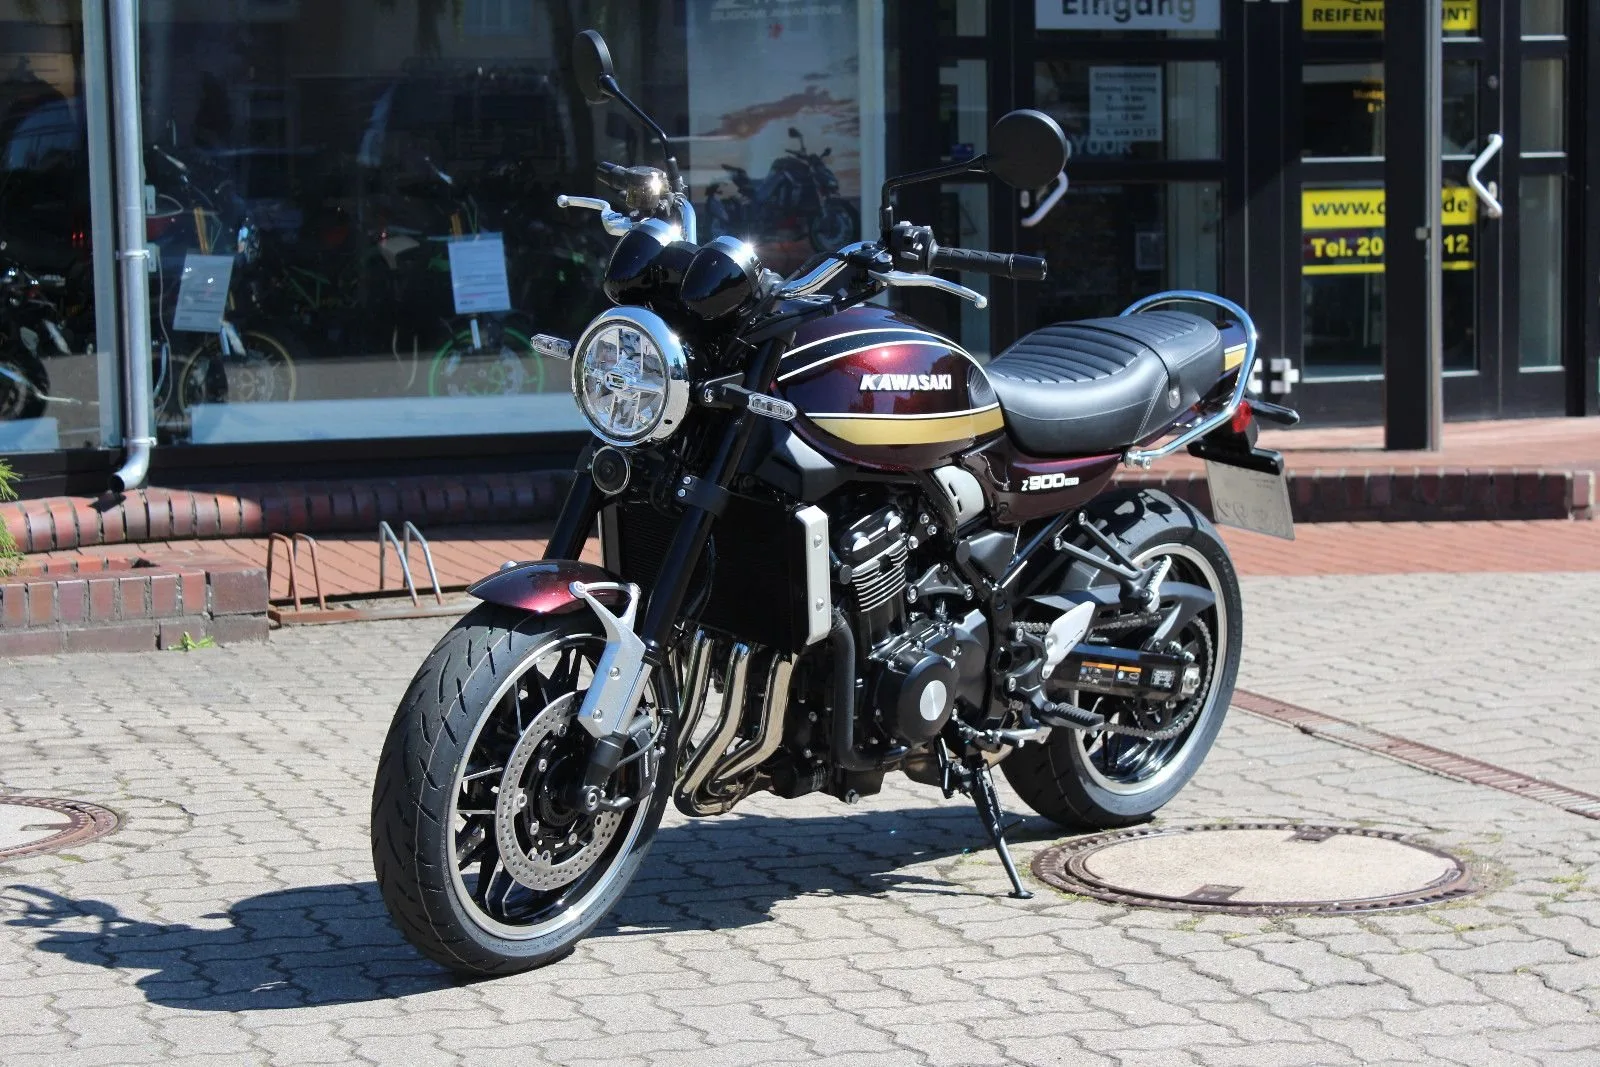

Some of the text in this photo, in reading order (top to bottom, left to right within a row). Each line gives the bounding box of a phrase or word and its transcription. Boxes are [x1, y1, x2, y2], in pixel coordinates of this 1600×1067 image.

[1062, 0, 1195, 23] Eingang
[1311, 237, 1352, 257] Tel.
[859, 374, 952, 391] KAWASAKI
